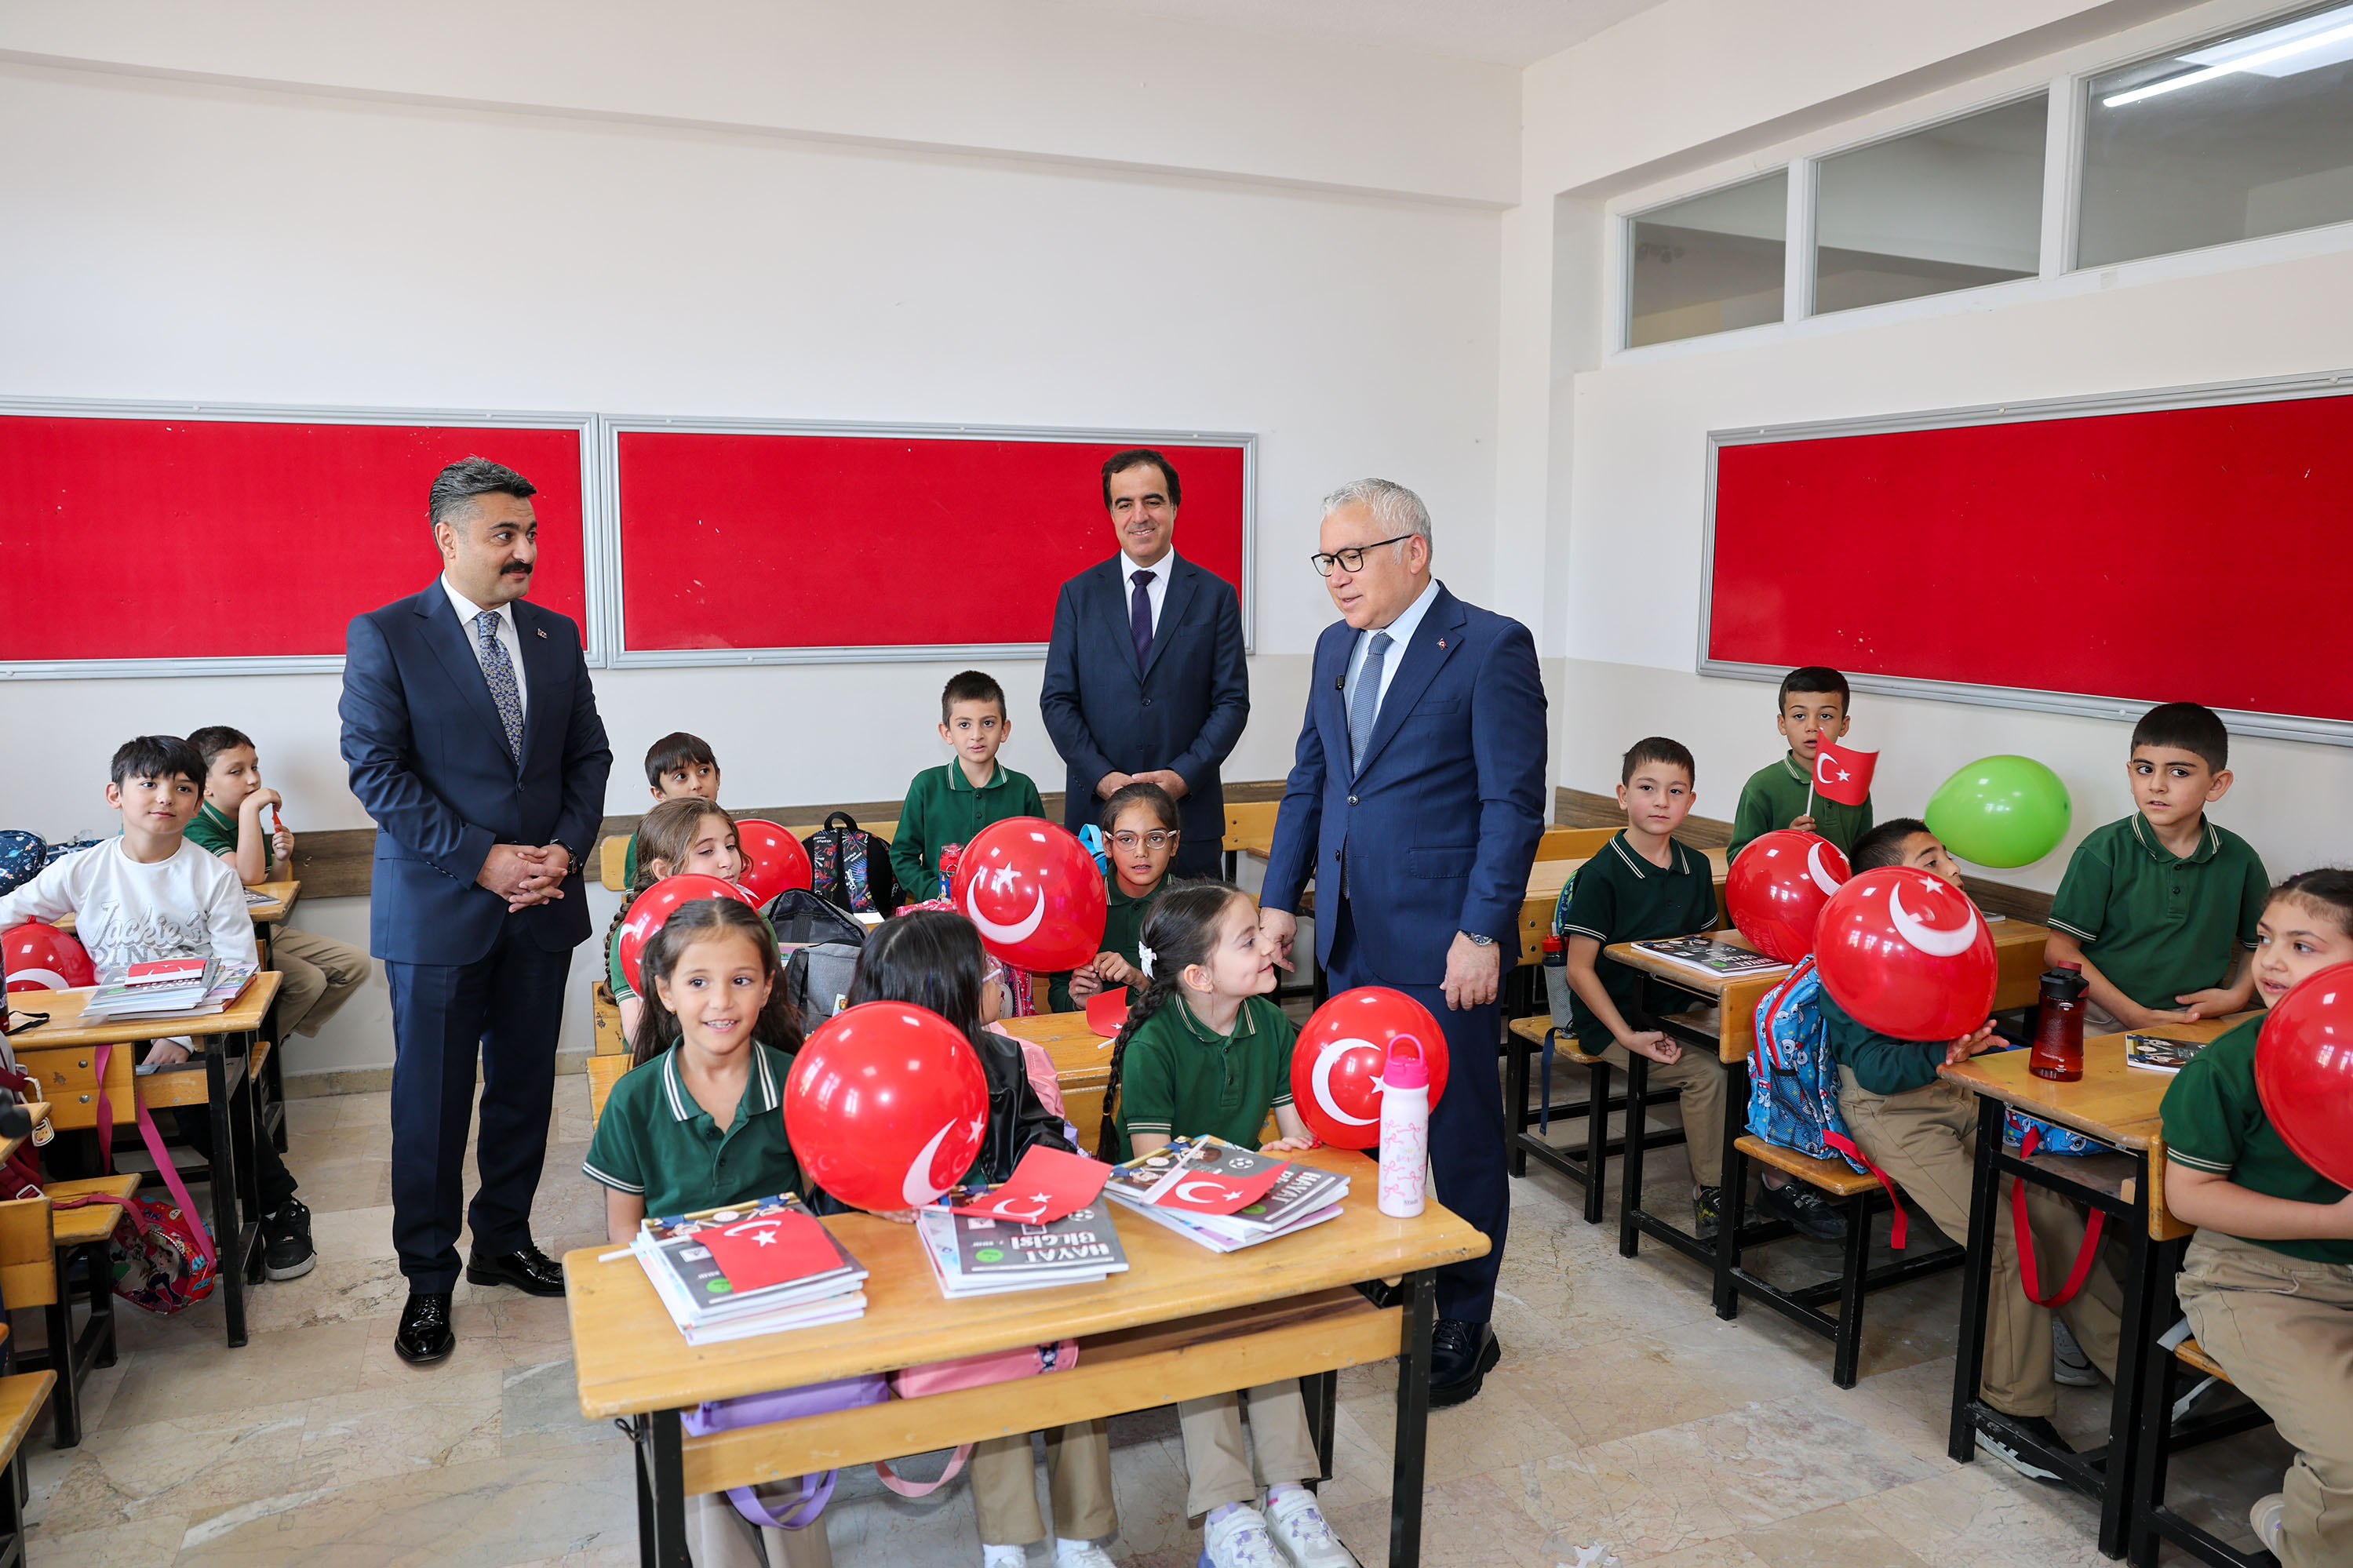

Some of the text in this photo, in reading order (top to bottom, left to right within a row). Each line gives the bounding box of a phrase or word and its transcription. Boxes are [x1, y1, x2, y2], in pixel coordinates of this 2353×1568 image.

[86, 901, 202, 949] Jackie's
[1271, 1171, 1321, 1205] HAYAT
[1025, 1242, 1109, 1263] HAYAT
